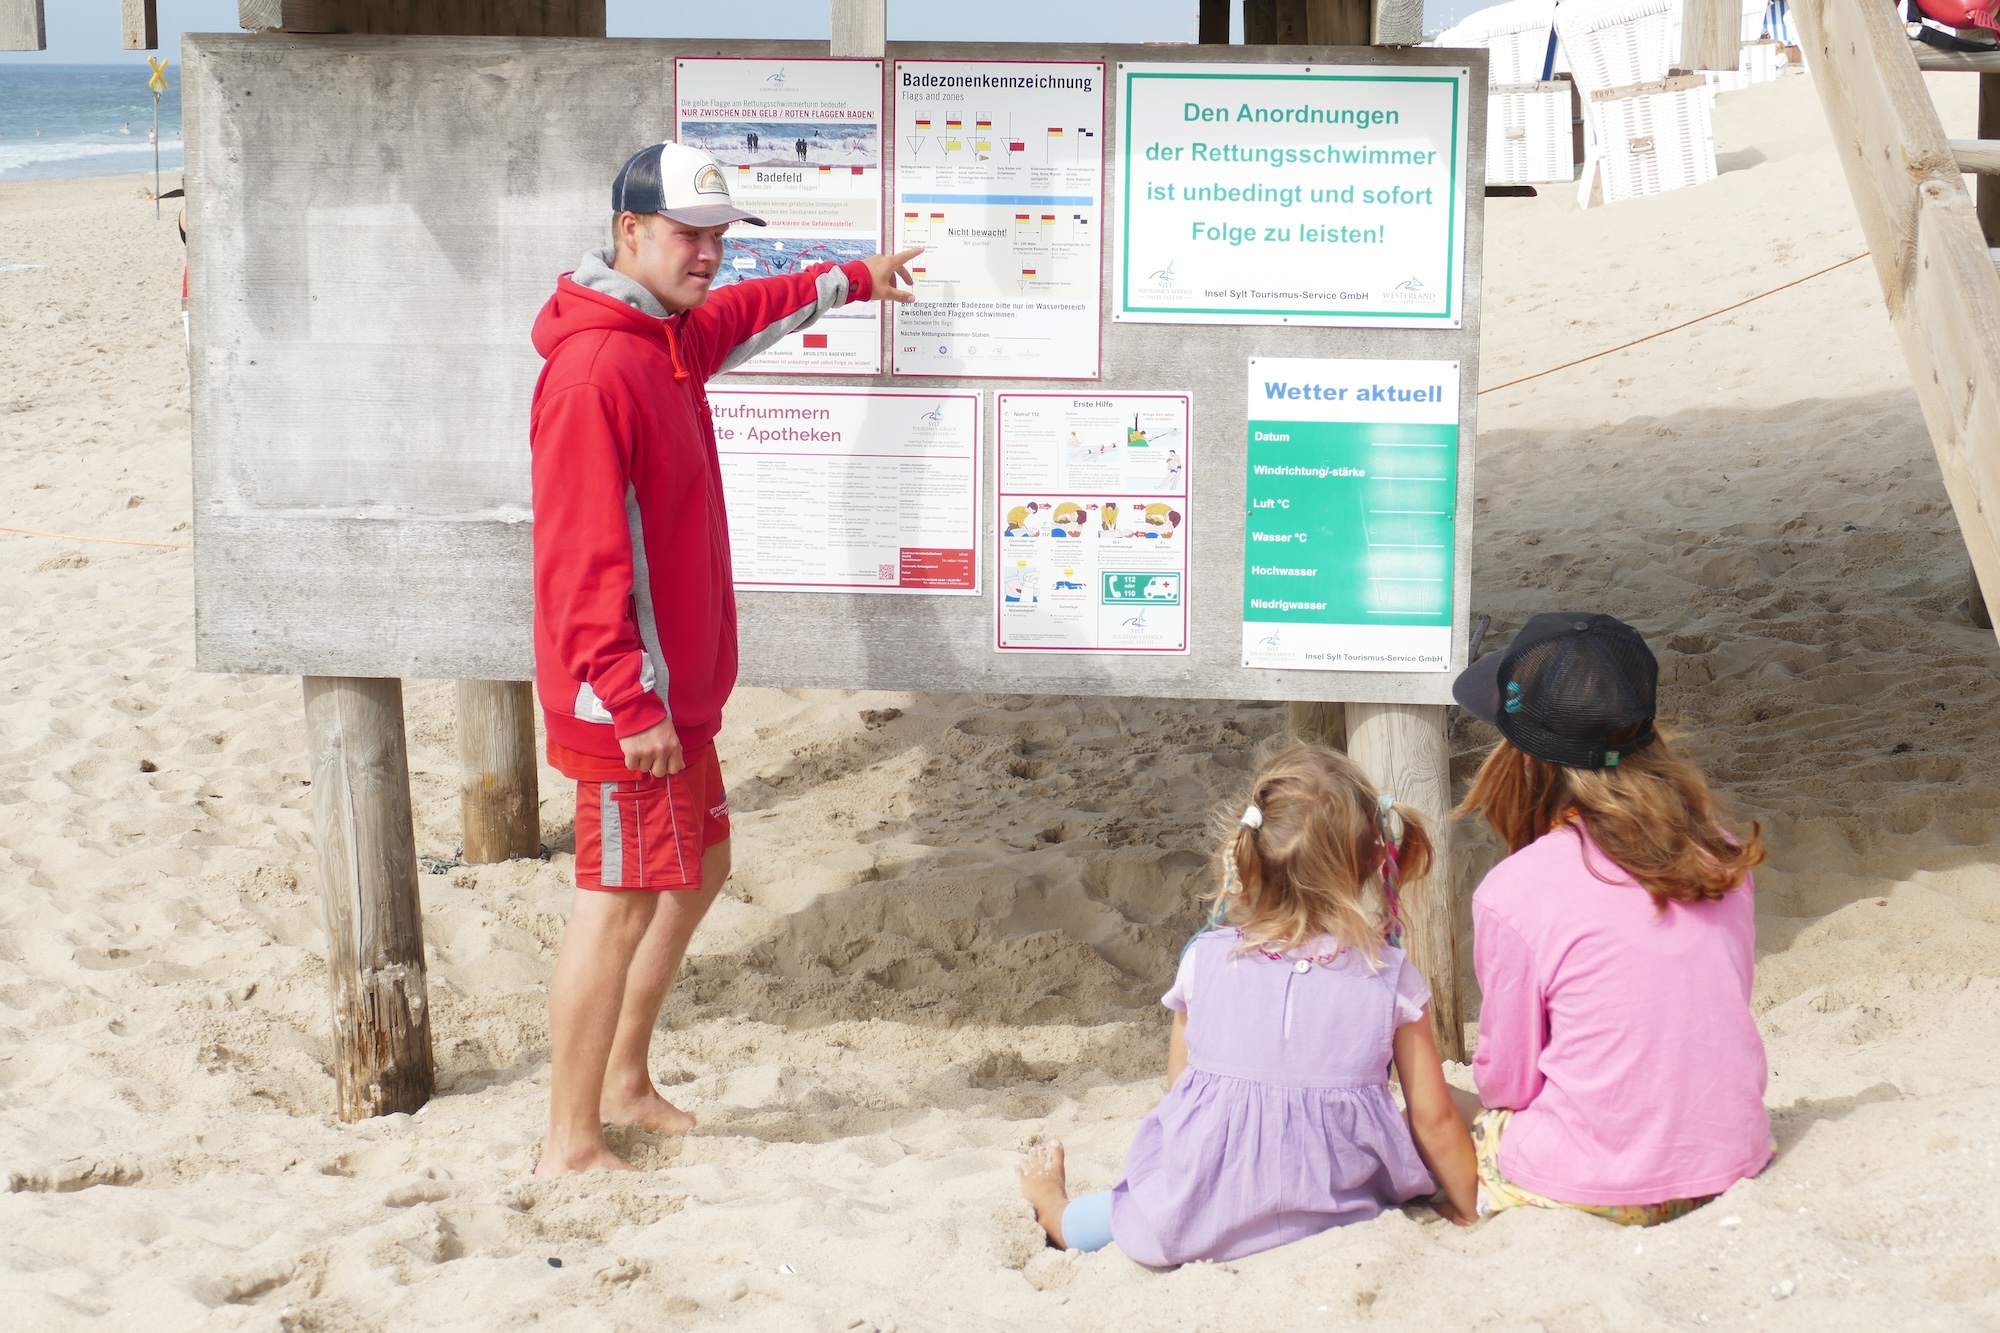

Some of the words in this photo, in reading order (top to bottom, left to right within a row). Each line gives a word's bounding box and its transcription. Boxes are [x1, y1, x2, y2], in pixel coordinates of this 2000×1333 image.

[903, 73, 1092, 92] Badezonenkennzeichnung
[903, 91, 923, 102] Flags
[926, 92, 940, 100] and
[1595, 90, 1615, 99] 1895
[693, 100, 709, 108] gelbe
[711, 100, 730, 108] Flagge
[744, 100, 818, 109] Rettungsschwimmerturm
[1184, 103, 1229, 122] Den
[1236, 104, 1399, 129] Anordnungen
[1145, 142, 1184, 161] der
[1192, 143, 1436, 167] Rettungsschwimmer
[757, 172, 802, 182] Badefeld
[1147, 182, 1175, 200] ist
[1183, 183, 1302, 207] unbedingt
[1310, 185, 1354, 203] und
[1363, 185, 1433, 205] sofort
[948, 228, 968, 236] Nicht
[971, 228, 1008, 237] bewacht!
[1192, 222, 1256, 245] Folge
[1264, 227, 1292, 242] zu
[1299, 224, 1385, 244] leisten!
[1205, 289, 1227, 298] Insel
[1230, 289, 1247, 300] Sylt
[1250, 290, 1337, 300] Tourismus-Service
[1340, 292, 1369, 300] GmbH
[1264, 382, 1348, 400] Wetter
[1356, 384, 1442, 402] aktuell
[711, 404, 829, 420] trufnummern
[714, 427, 734, 440] te
[747, 427, 841, 444] Apotheken
[1255, 431, 1289, 442] Datum
[1254, 465, 1365, 478] Windrichtung/-stärke
[1253, 498, 1275, 508] Luft
[1277, 499, 1290, 508] °C
[1252, 532, 1292, 542] Wasser
[1295, 533, 1307, 543] °C
[1251, 566, 1317, 577] Hochwasser
[1251, 599, 1327, 611] Niedrigwasser
[1326, 653, 1341, 661] Sylt
[1343, 654, 1416, 662] Tourismus-Service
